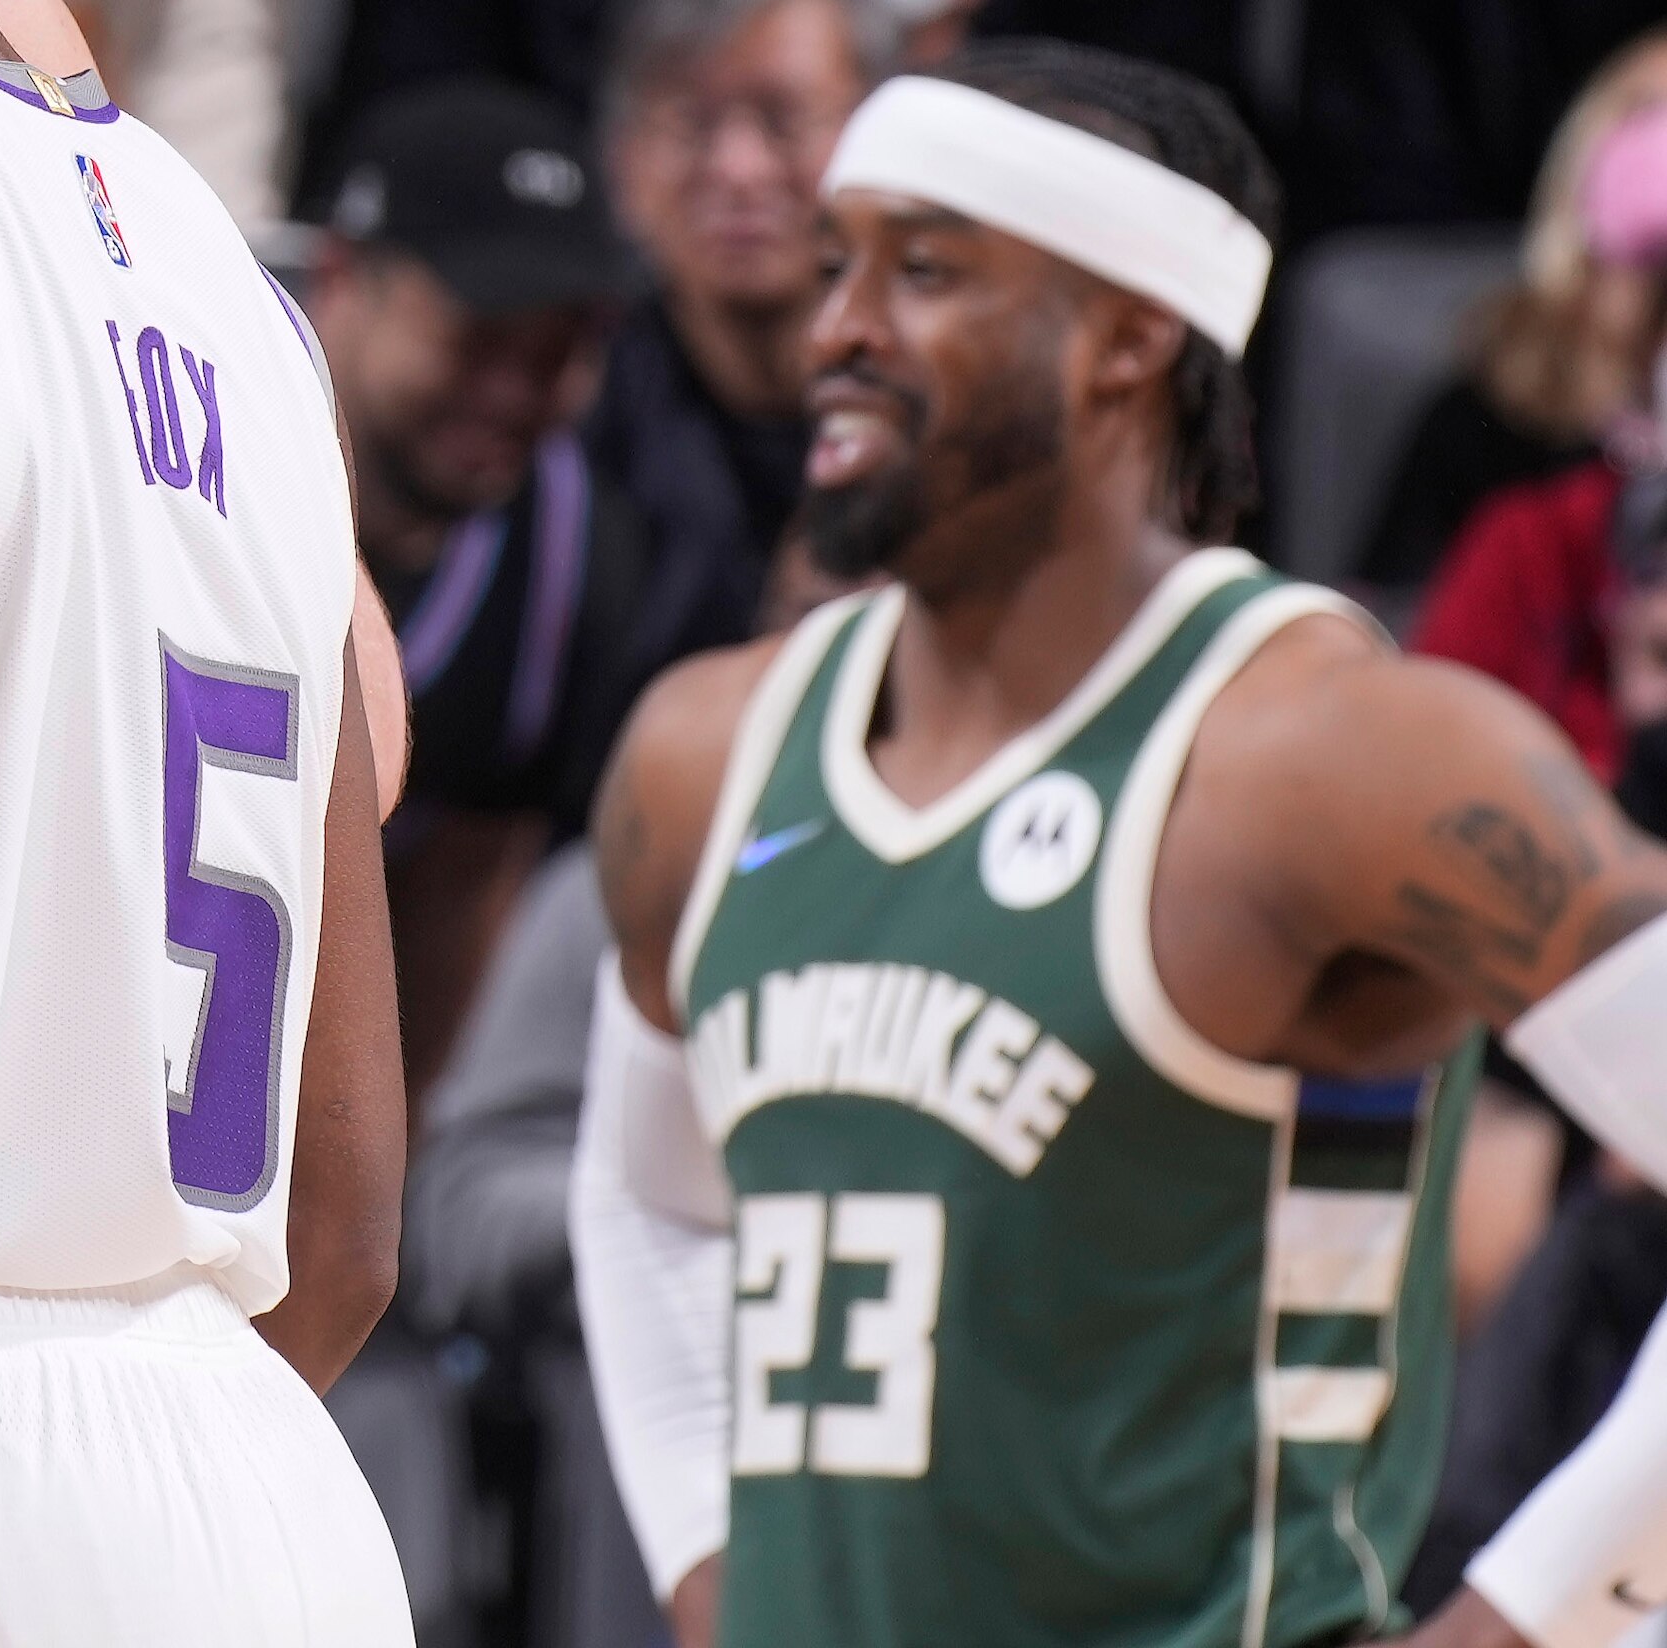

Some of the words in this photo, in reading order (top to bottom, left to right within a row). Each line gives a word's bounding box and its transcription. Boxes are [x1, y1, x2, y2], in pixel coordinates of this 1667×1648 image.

[106, 320, 227, 519] FOX
[156, 627, 300, 1213] 5
[732, 1191, 948, 1478] 23
